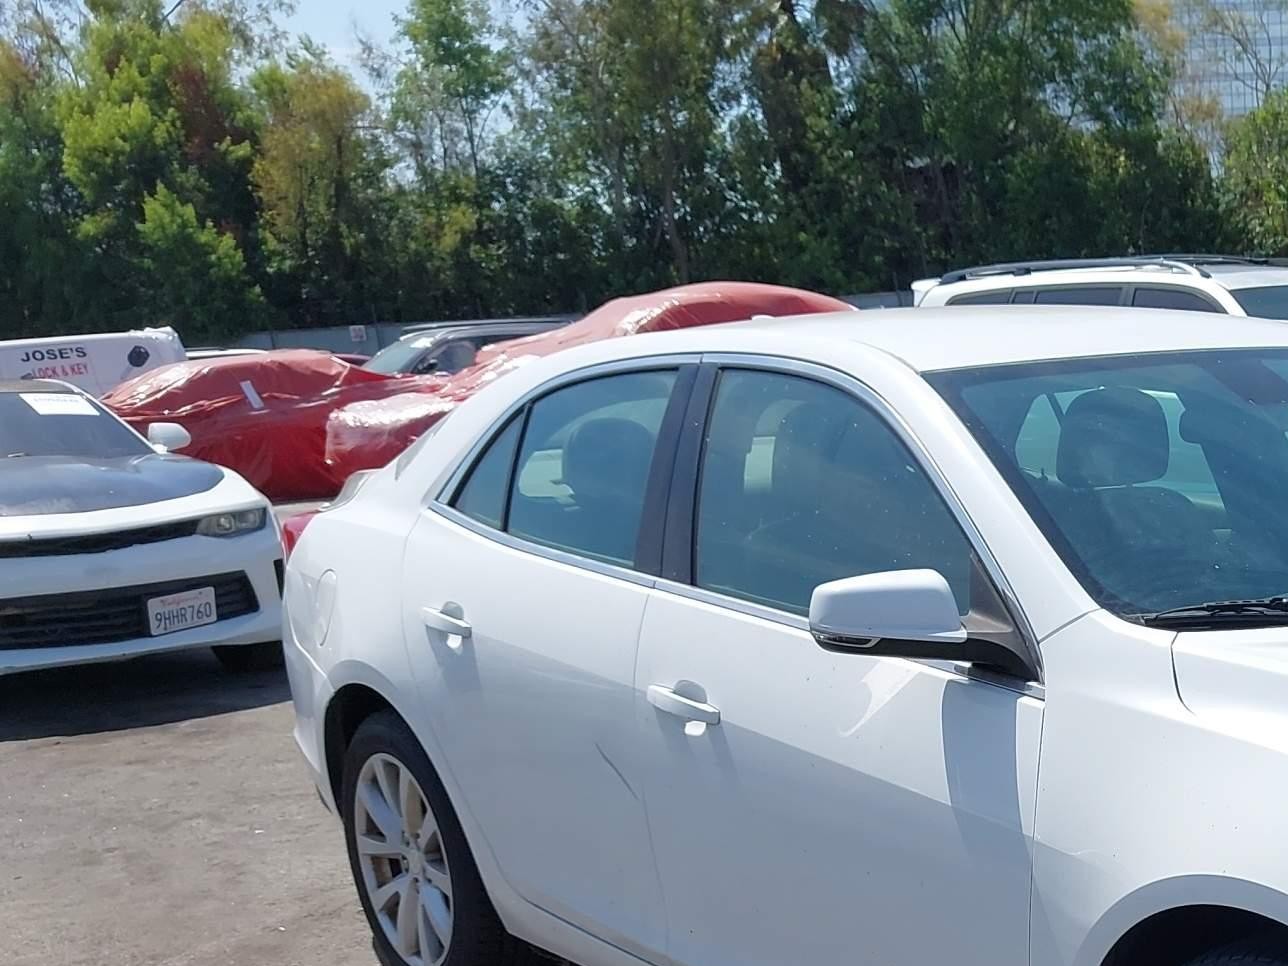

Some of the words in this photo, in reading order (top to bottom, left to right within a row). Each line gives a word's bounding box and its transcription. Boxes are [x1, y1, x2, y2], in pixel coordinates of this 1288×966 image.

[21, 346, 87, 362] JOSE'S
[31, 366, 59, 379] LOCK
[70, 362, 89, 376] KEY
[154, 601, 212, 629] 9HHR760
